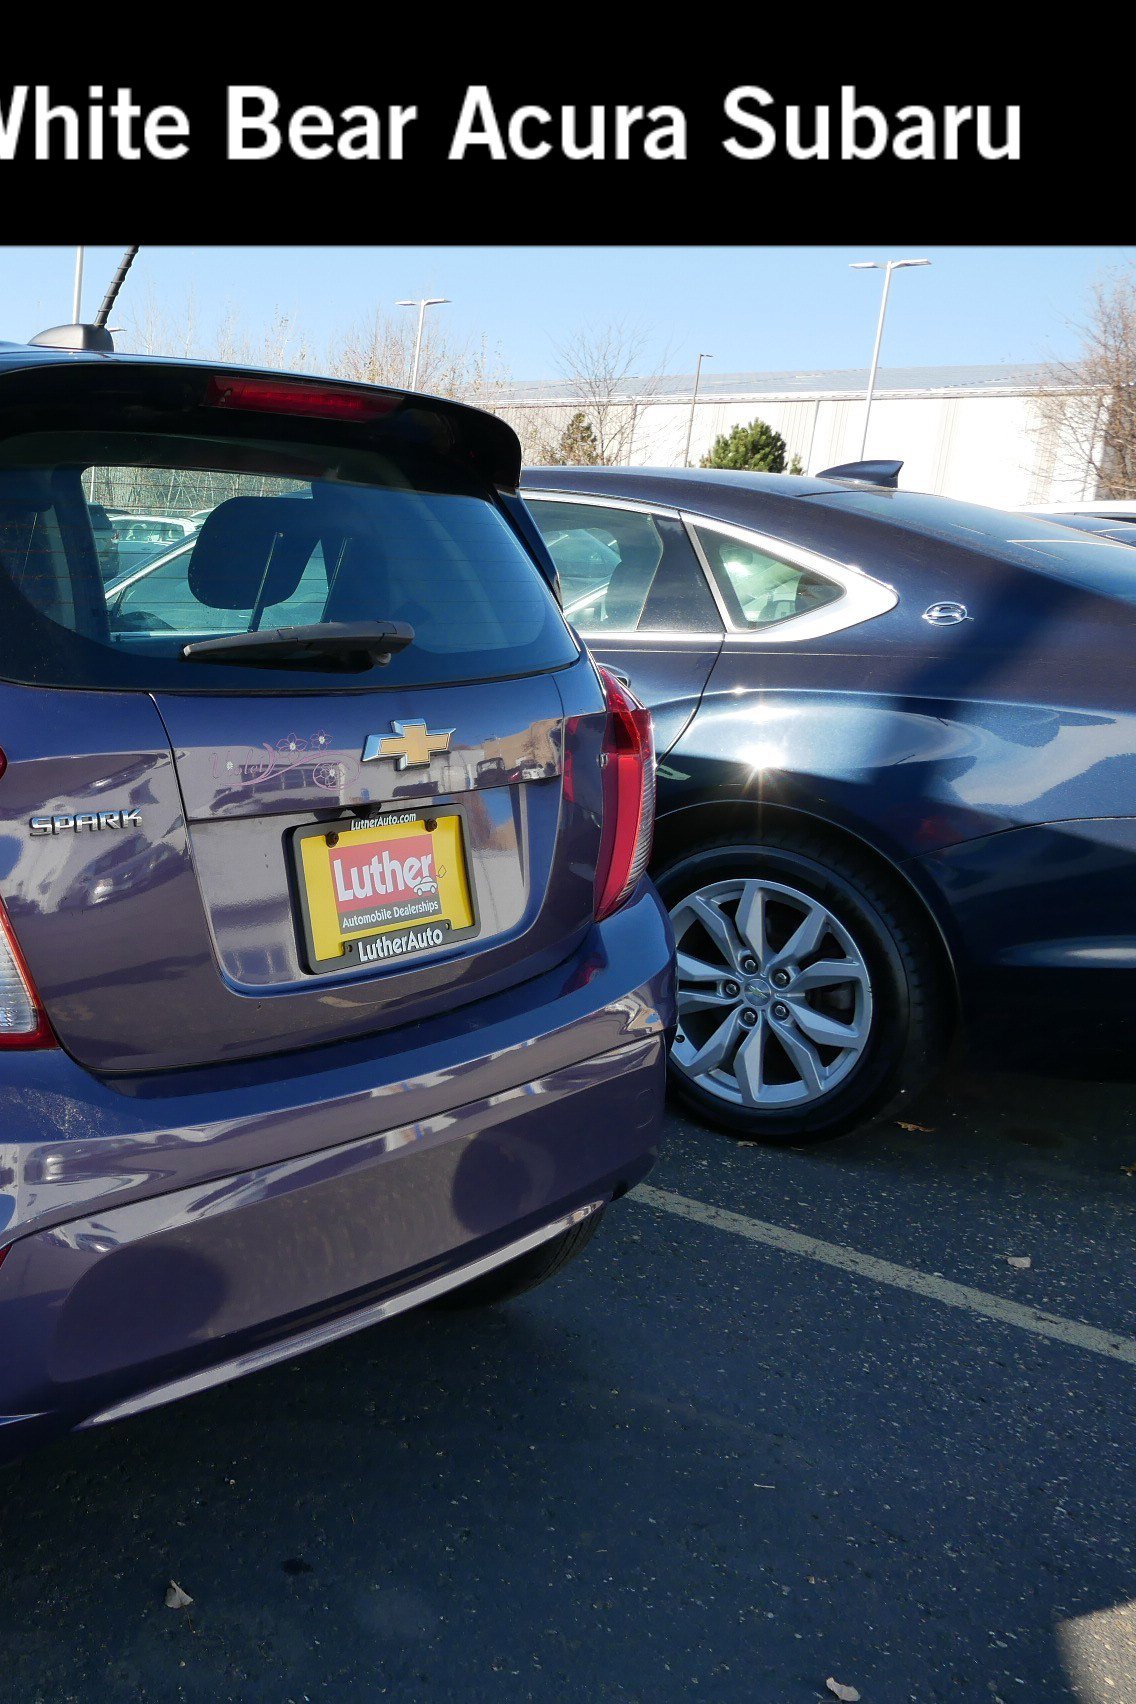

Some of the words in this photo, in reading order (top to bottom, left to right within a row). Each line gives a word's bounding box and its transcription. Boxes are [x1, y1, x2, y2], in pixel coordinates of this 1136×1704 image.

[29, 808, 143, 837] SPARK
[351, 813, 416, 830] LutherAuto.com
[333, 850, 433, 902] Luther
[342, 908, 392, 929] Automobile
[393, 900, 439, 919] Dealerships
[358, 928, 443, 962] LutherAuto
